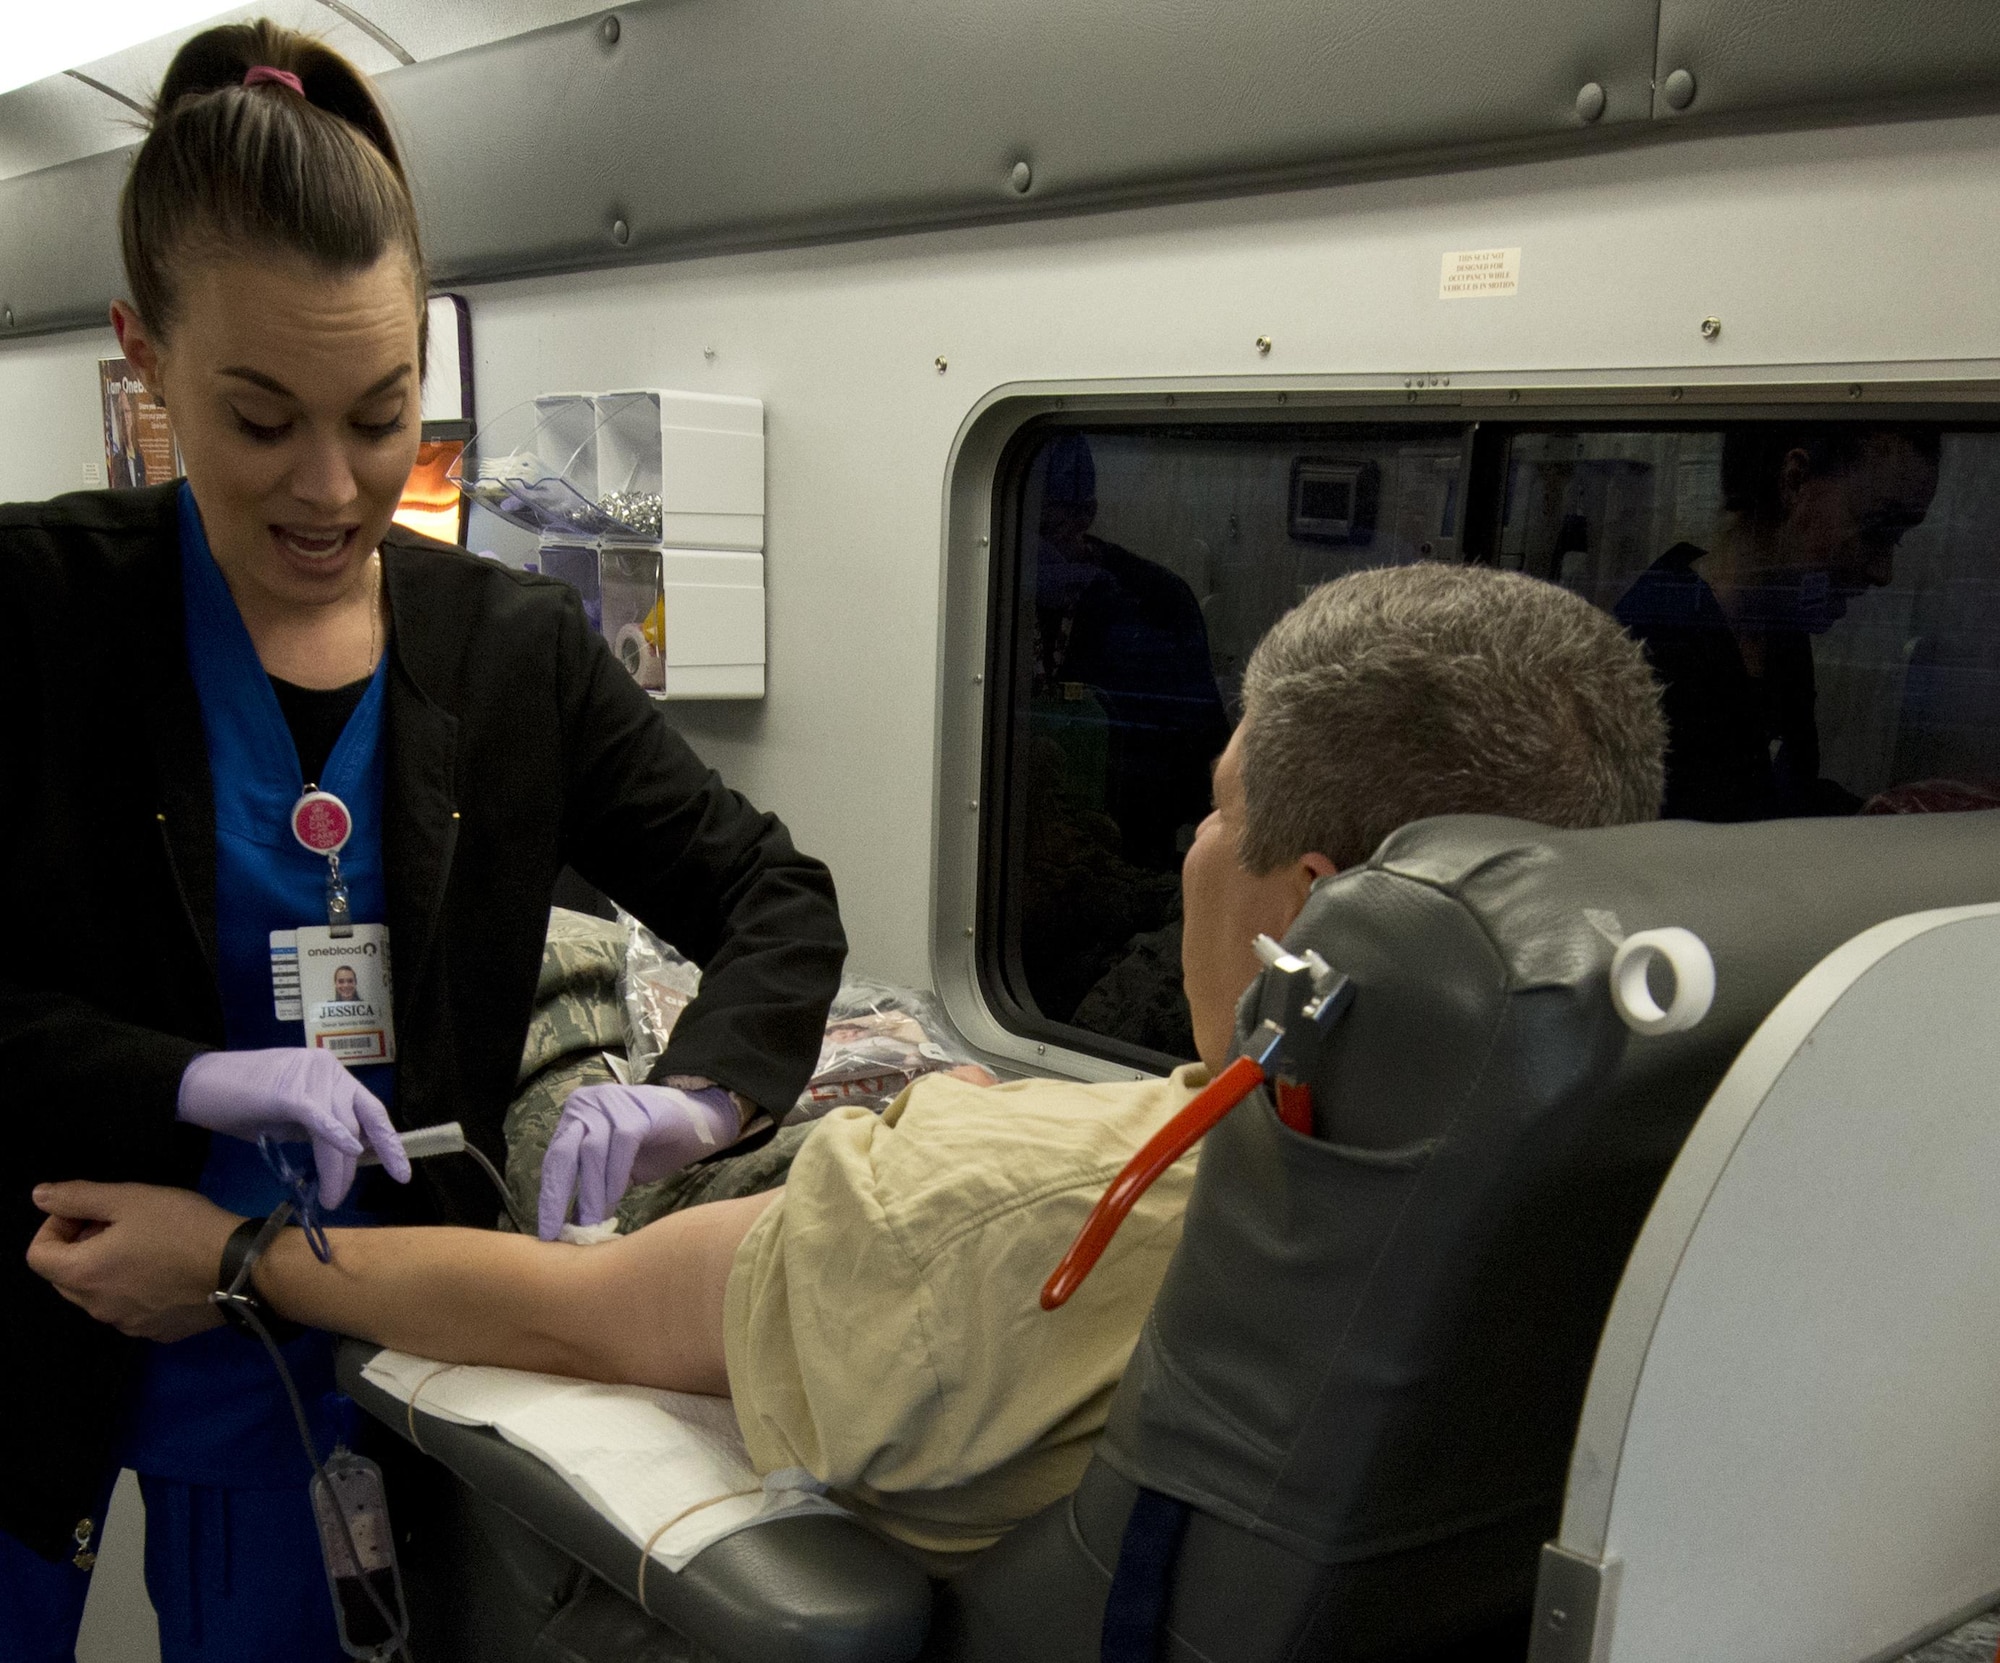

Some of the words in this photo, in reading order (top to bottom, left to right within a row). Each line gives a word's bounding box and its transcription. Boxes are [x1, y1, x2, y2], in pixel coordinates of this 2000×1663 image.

[1459, 254, 1473, 262] THIS
[1474, 253, 1489, 261] SEAT
[1491, 252, 1504, 260] NOT
[1456, 263, 1489, 272] DESIGNED
[1490, 262, 1504, 270] FOR
[1448, 273, 1487, 282] OCCUPANCY
[1488, 271, 1509, 279] WHILE
[1443, 283, 1471, 292] VEHICLE
[1488, 281, 1515, 289] MOTION
[308, 945, 362, 957] oneblood
[319, 1004, 375, 1019] JESSICA
